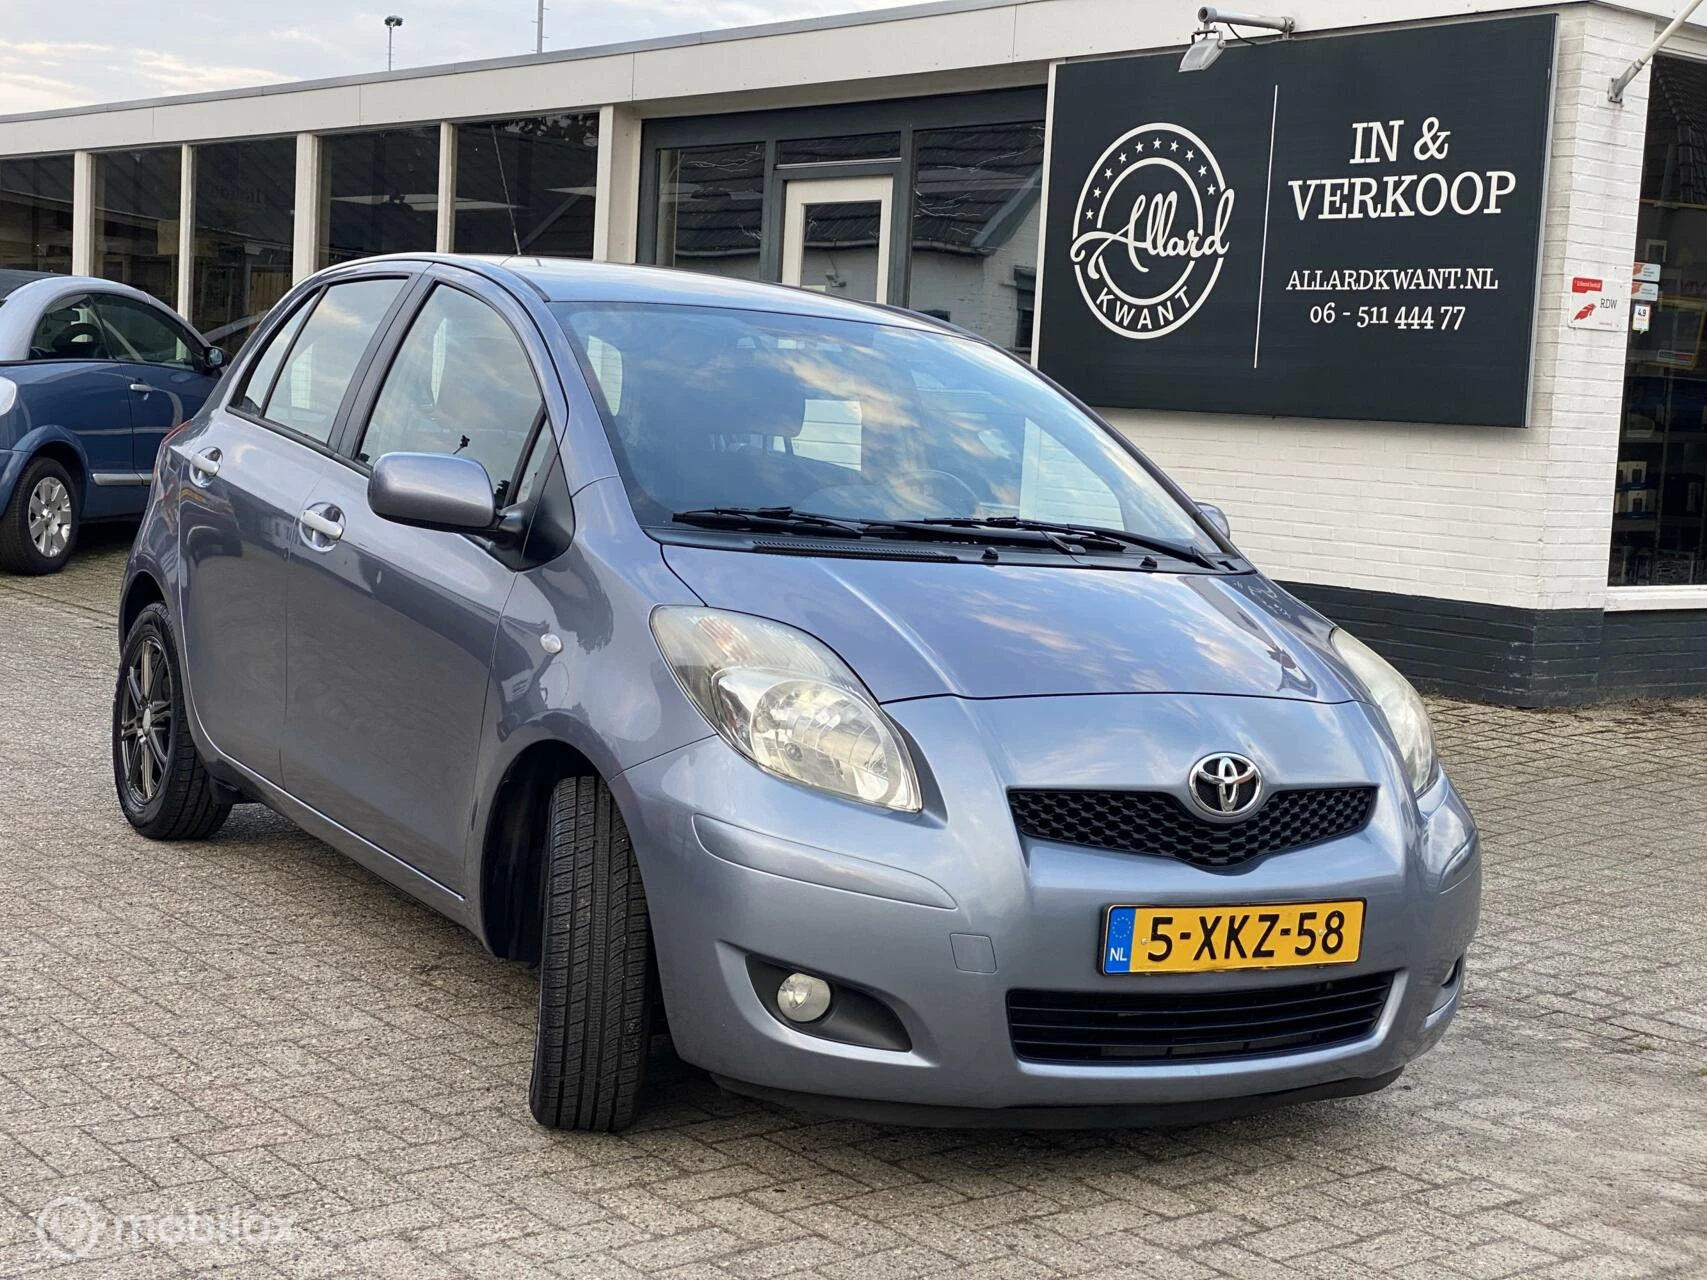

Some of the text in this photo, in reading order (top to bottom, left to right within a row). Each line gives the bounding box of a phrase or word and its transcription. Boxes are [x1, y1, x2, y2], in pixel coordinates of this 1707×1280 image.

[1349, 116, 1451, 164] IN &
[1287, 170, 1517, 221] VERKOOP
[1070, 188, 1235, 280] Allard
[1285, 268, 1499, 291] ALLARDKWANT.NL
[1095, 285, 1192, 330] KWANT
[1309, 301, 1336, 324] 06
[1356, 305, 1389, 328] 511
[1394, 305, 1435, 330] 444
[1439, 305, 1466, 331] 77
[1599, 297, 1618, 310] RDW
[1109, 946, 1127, 962] NL
[1147, 909, 1346, 963] 5-XKZ-58
